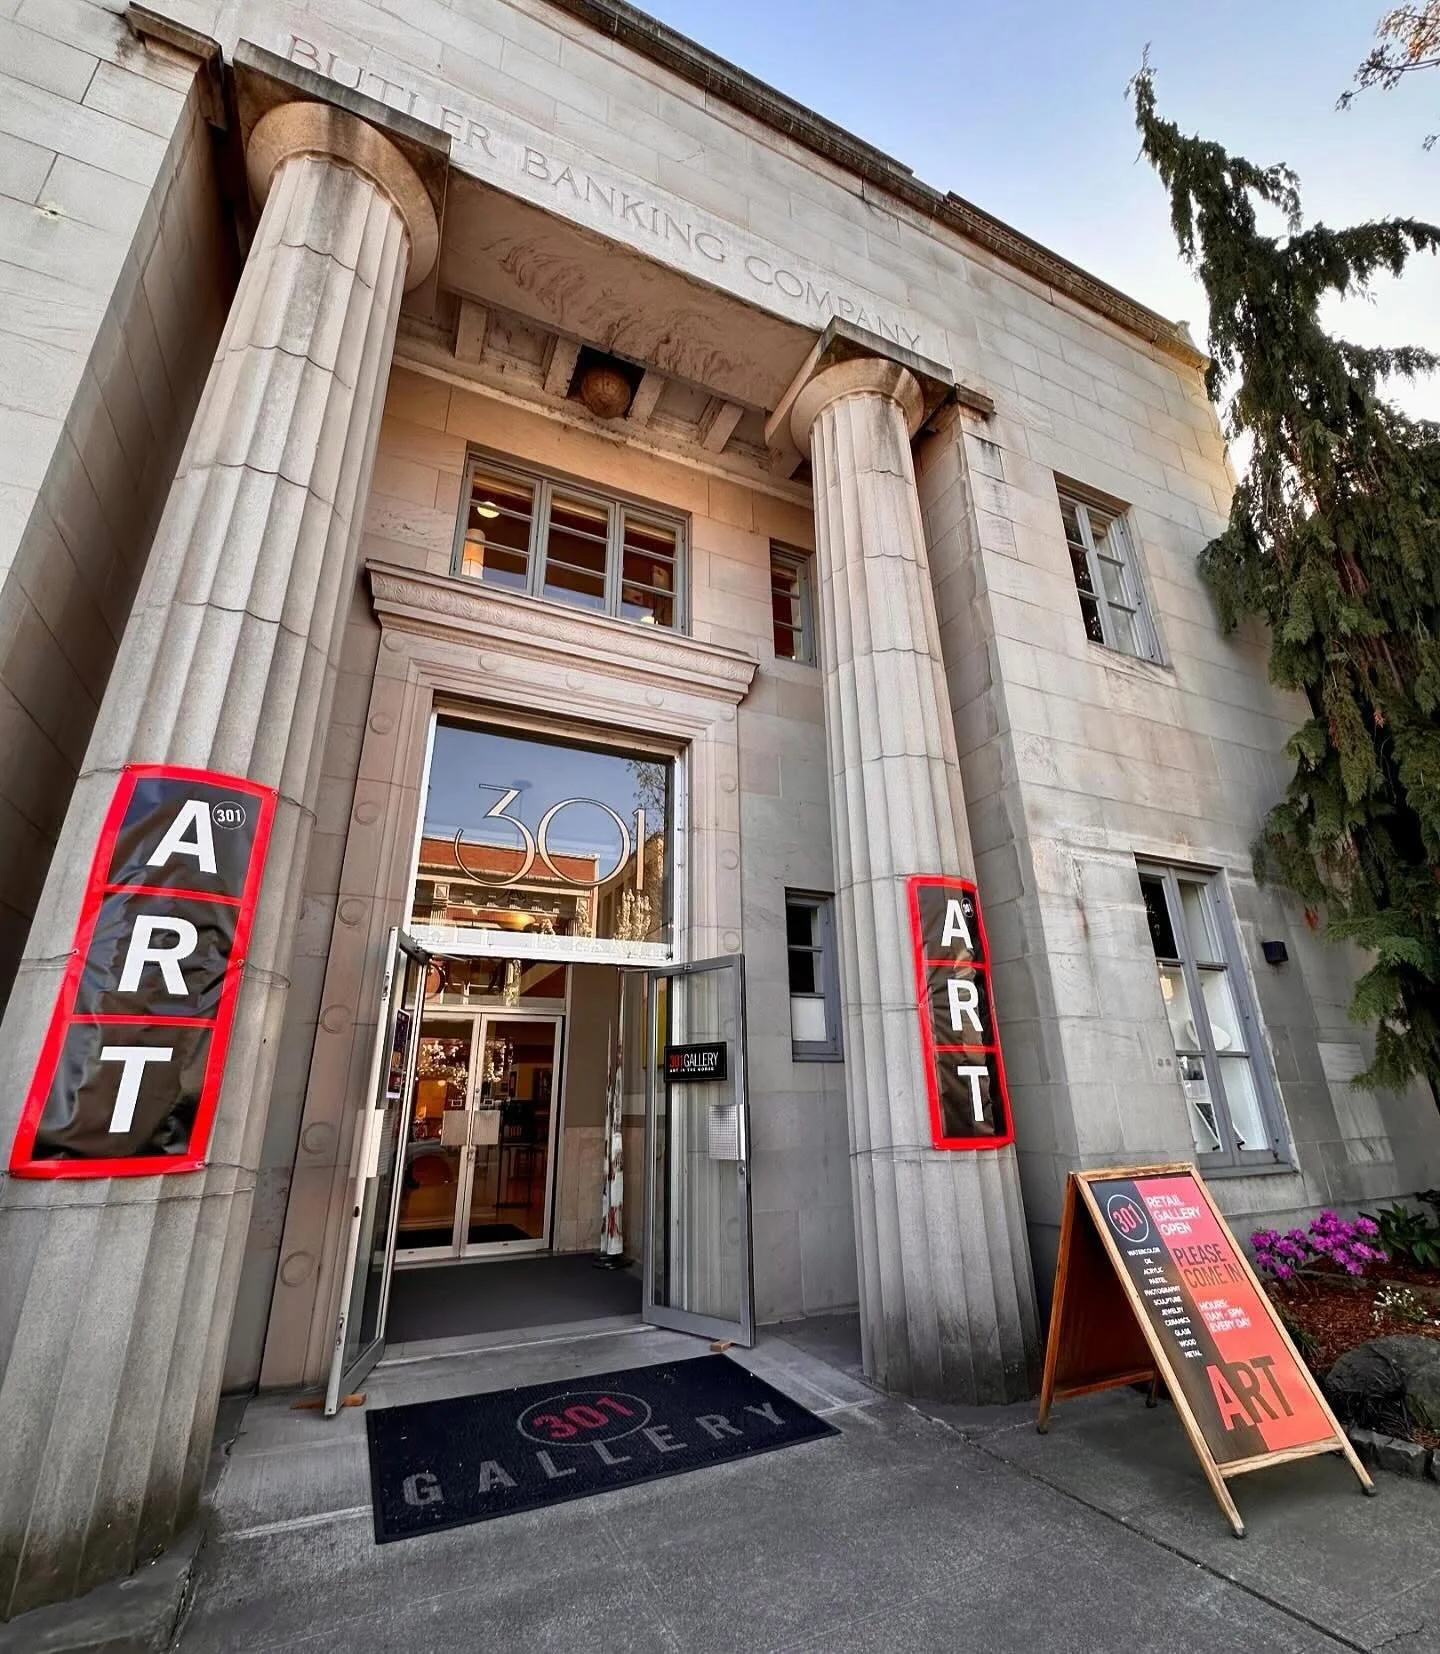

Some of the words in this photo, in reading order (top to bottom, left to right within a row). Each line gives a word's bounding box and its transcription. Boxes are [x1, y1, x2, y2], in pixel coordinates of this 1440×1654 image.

[290, 33, 496, 159] BUTLER
[521, 146, 726, 263] BANKING
[744, 254, 920, 351] COMPANY
[215, 808, 243, 823] 301
[454, 783, 646, 891] 301
[100, 799, 217, 1134] ART
[941, 899, 988, 1122] ART
[1146, 1194, 1184, 1209] RETAIL
[1112, 1202, 1143, 1233] 301
[1153, 1206, 1201, 1222] GALLERY
[1160, 1221, 1193, 1236] OPEN
[1127, 1246, 1161, 1256] WATERCOLOR
[1172, 1243, 1227, 1268] PLEASE
[1143, 1266, 1164, 1275] ACRYLIC
[1184, 1264, 1229, 1289] COME
[1223, 1262, 1245, 1284] IN
[1148, 1276, 1168, 1285] PASTEL
[1144, 1286, 1181, 1296] PHOTOGRAPHY
[1153, 1296, 1182, 1306] SCULPTURE
[1161, 1306, 1184, 1316] JEWELRY
[1164, 1316, 1191, 1326] CERAMICS
[1209, 1318, 1234, 1333] EVERY
[1232, 1316, 1251, 1330] DAY
[1174, 1327, 1192, 1337] GLASS
[1178, 1338, 1197, 1348] WOOD
[1184, 1349, 1203, 1358] METAL
[1206, 1355, 1294, 1431] ART
[532, 1396, 635, 1438] 301
[403, 1401, 786, 1507] GALLERY
